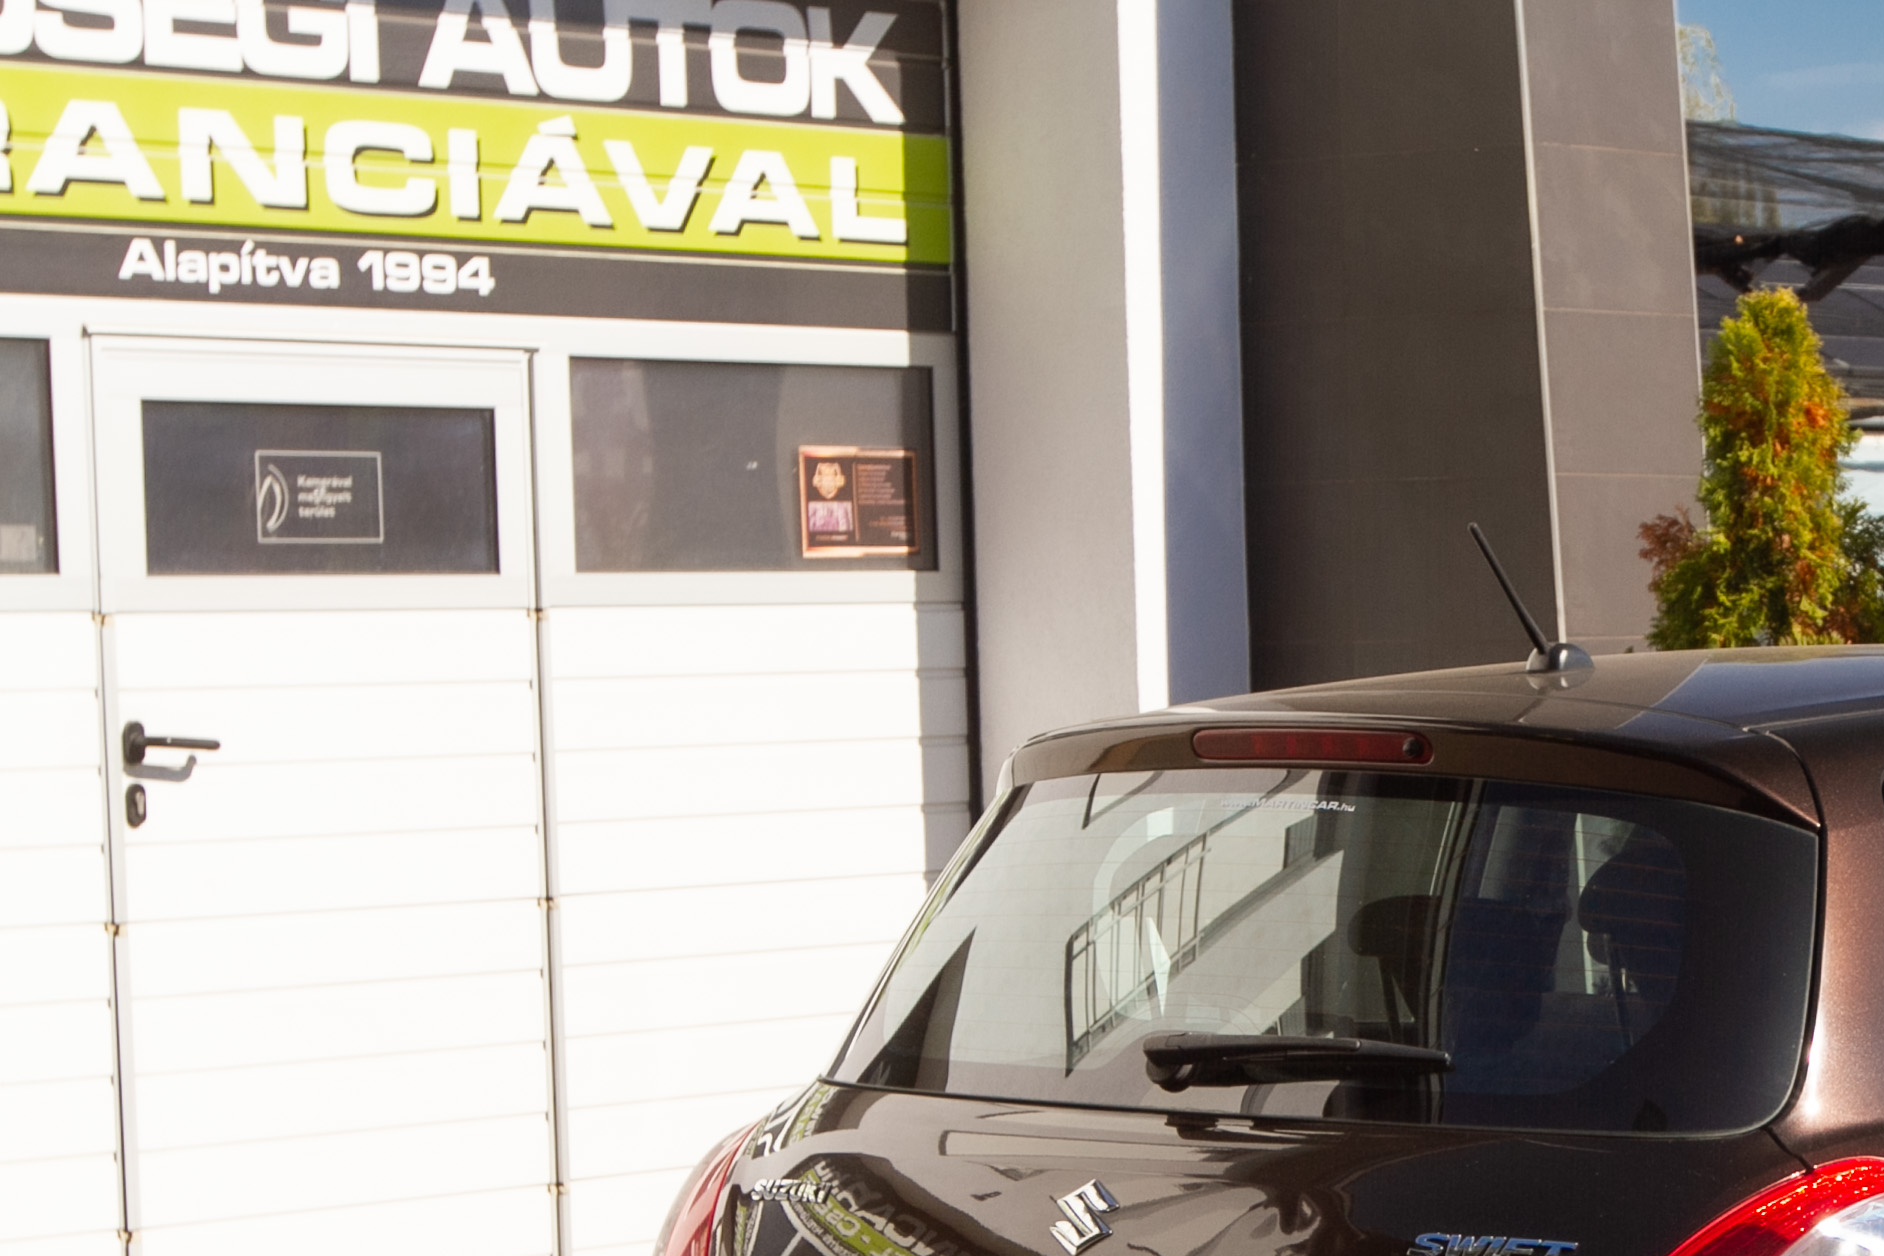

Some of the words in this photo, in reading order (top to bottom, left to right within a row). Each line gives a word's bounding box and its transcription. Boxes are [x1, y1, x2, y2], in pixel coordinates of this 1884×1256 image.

[0, 99, 908, 244] ANCIÁVAL
[118, 238, 341, 294] Alapítva
[357, 250, 496, 297] 1994
[751, 1178, 832, 1204] SUZUKI
